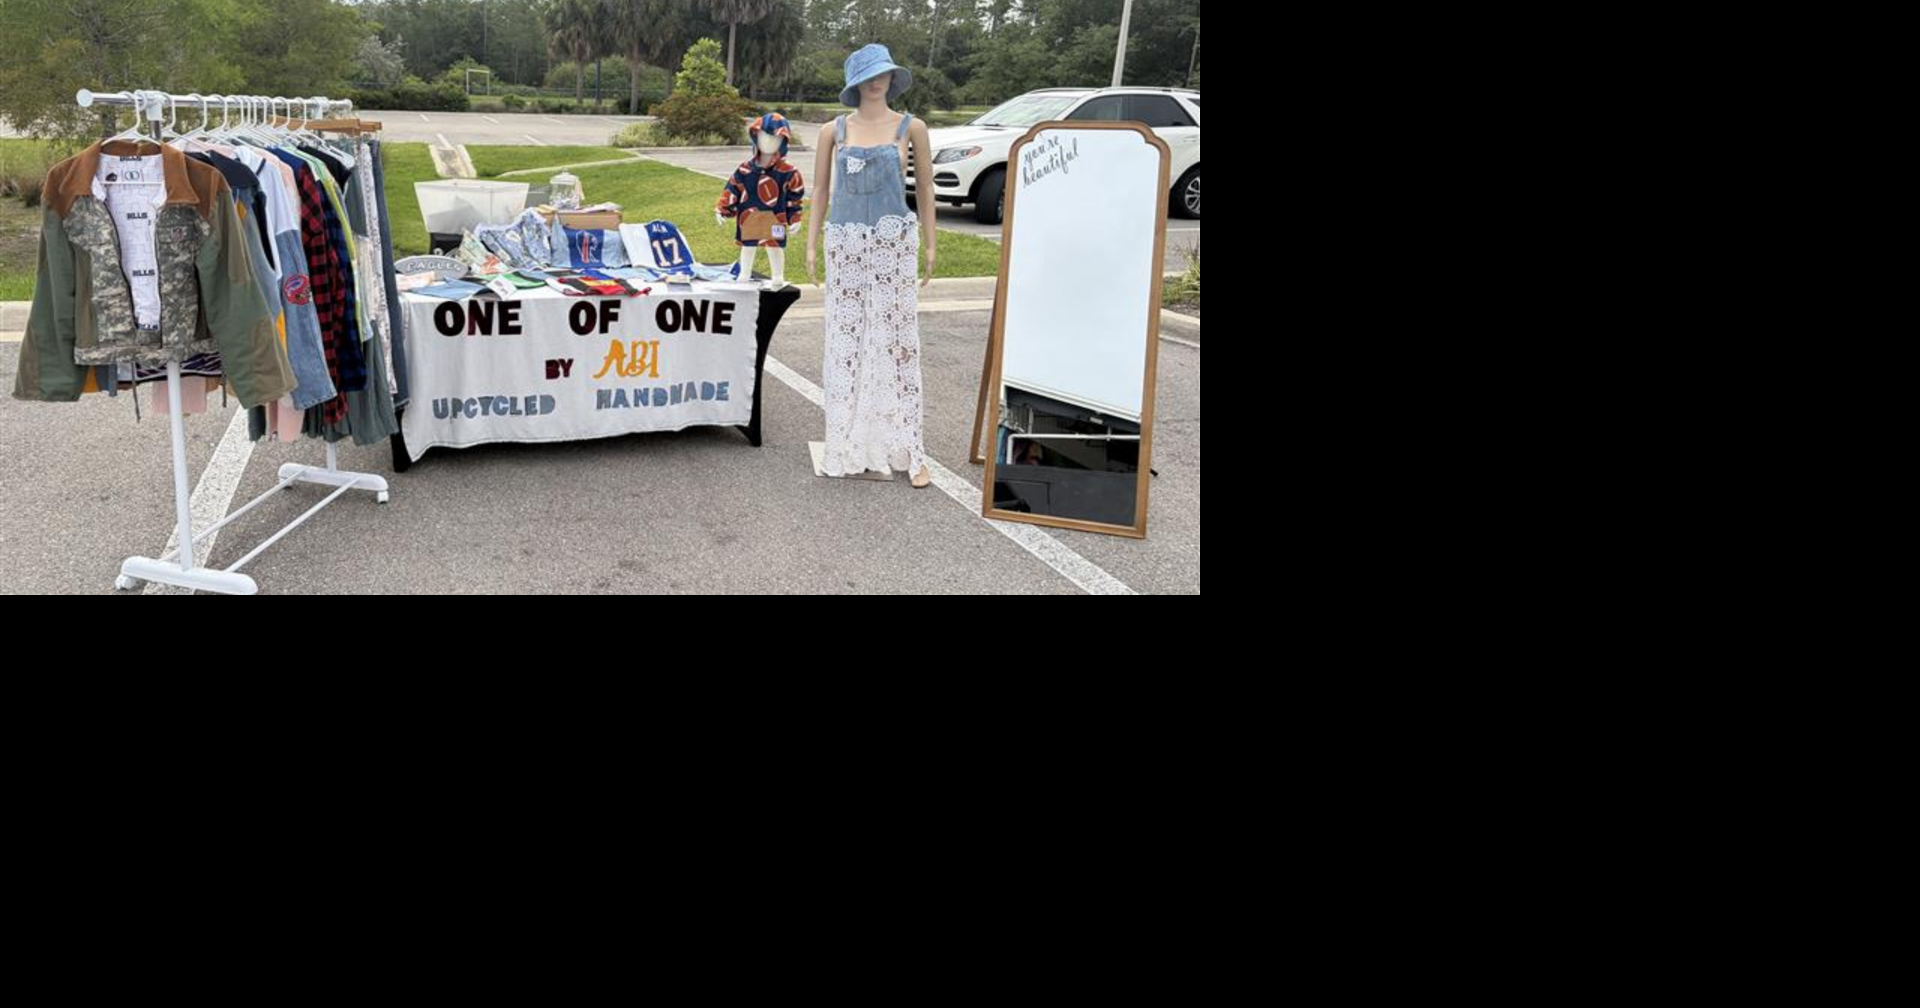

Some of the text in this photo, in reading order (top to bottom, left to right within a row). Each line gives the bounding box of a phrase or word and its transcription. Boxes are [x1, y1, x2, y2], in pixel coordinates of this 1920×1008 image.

[1022, 137, 1080, 188] beautiful
[652, 237, 684, 267] 17
[433, 299, 736, 337] ONE OF ONE
[545, 337, 661, 380] BY ABI
[432, 394, 556, 420] UPCYCLED
